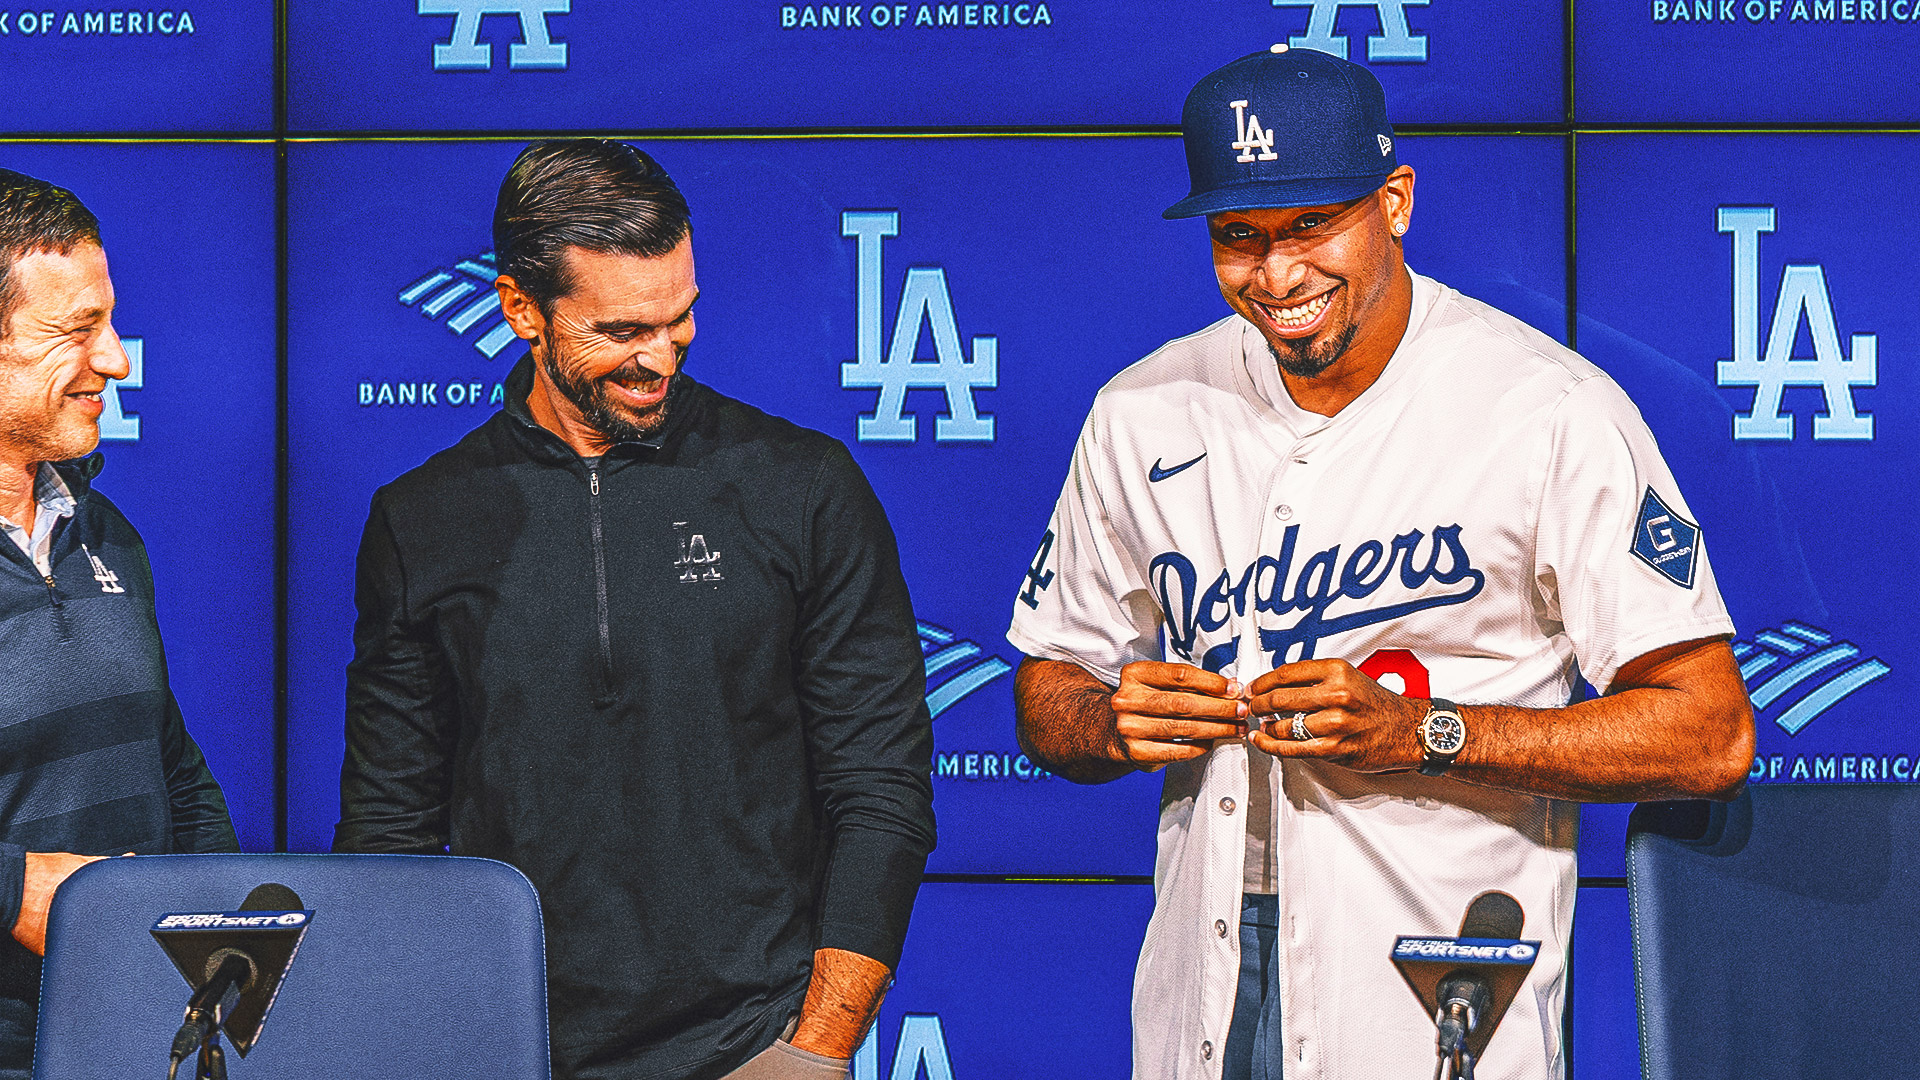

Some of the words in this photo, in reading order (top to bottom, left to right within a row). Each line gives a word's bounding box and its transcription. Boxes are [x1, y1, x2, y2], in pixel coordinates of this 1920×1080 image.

[782, 5, 862, 28] BANK
[870, 5, 908, 27] OF
[914, 4, 1051, 27] AMERICA
[1653, 0, 1735, 21] BANK
[1744, 0, 1781, 21] OF
[17, 12, 55, 34] OF
[61, 11, 194, 35] AMERICA
[1230, 99, 1278, 163] LA
[841, 210, 998, 442] LA
[1716, 206, 1878, 440] LA
[359, 382, 438, 405] BANK
[446, 382, 483, 405] OF
[81, 543, 125, 593] LA
[1149, 523, 1486, 673] Dodgers
[931, 753, 1051, 777] MERIC
[157, 916, 279, 929] SPORTSNET
[1395, 943, 1509, 960] SPORTSNET
